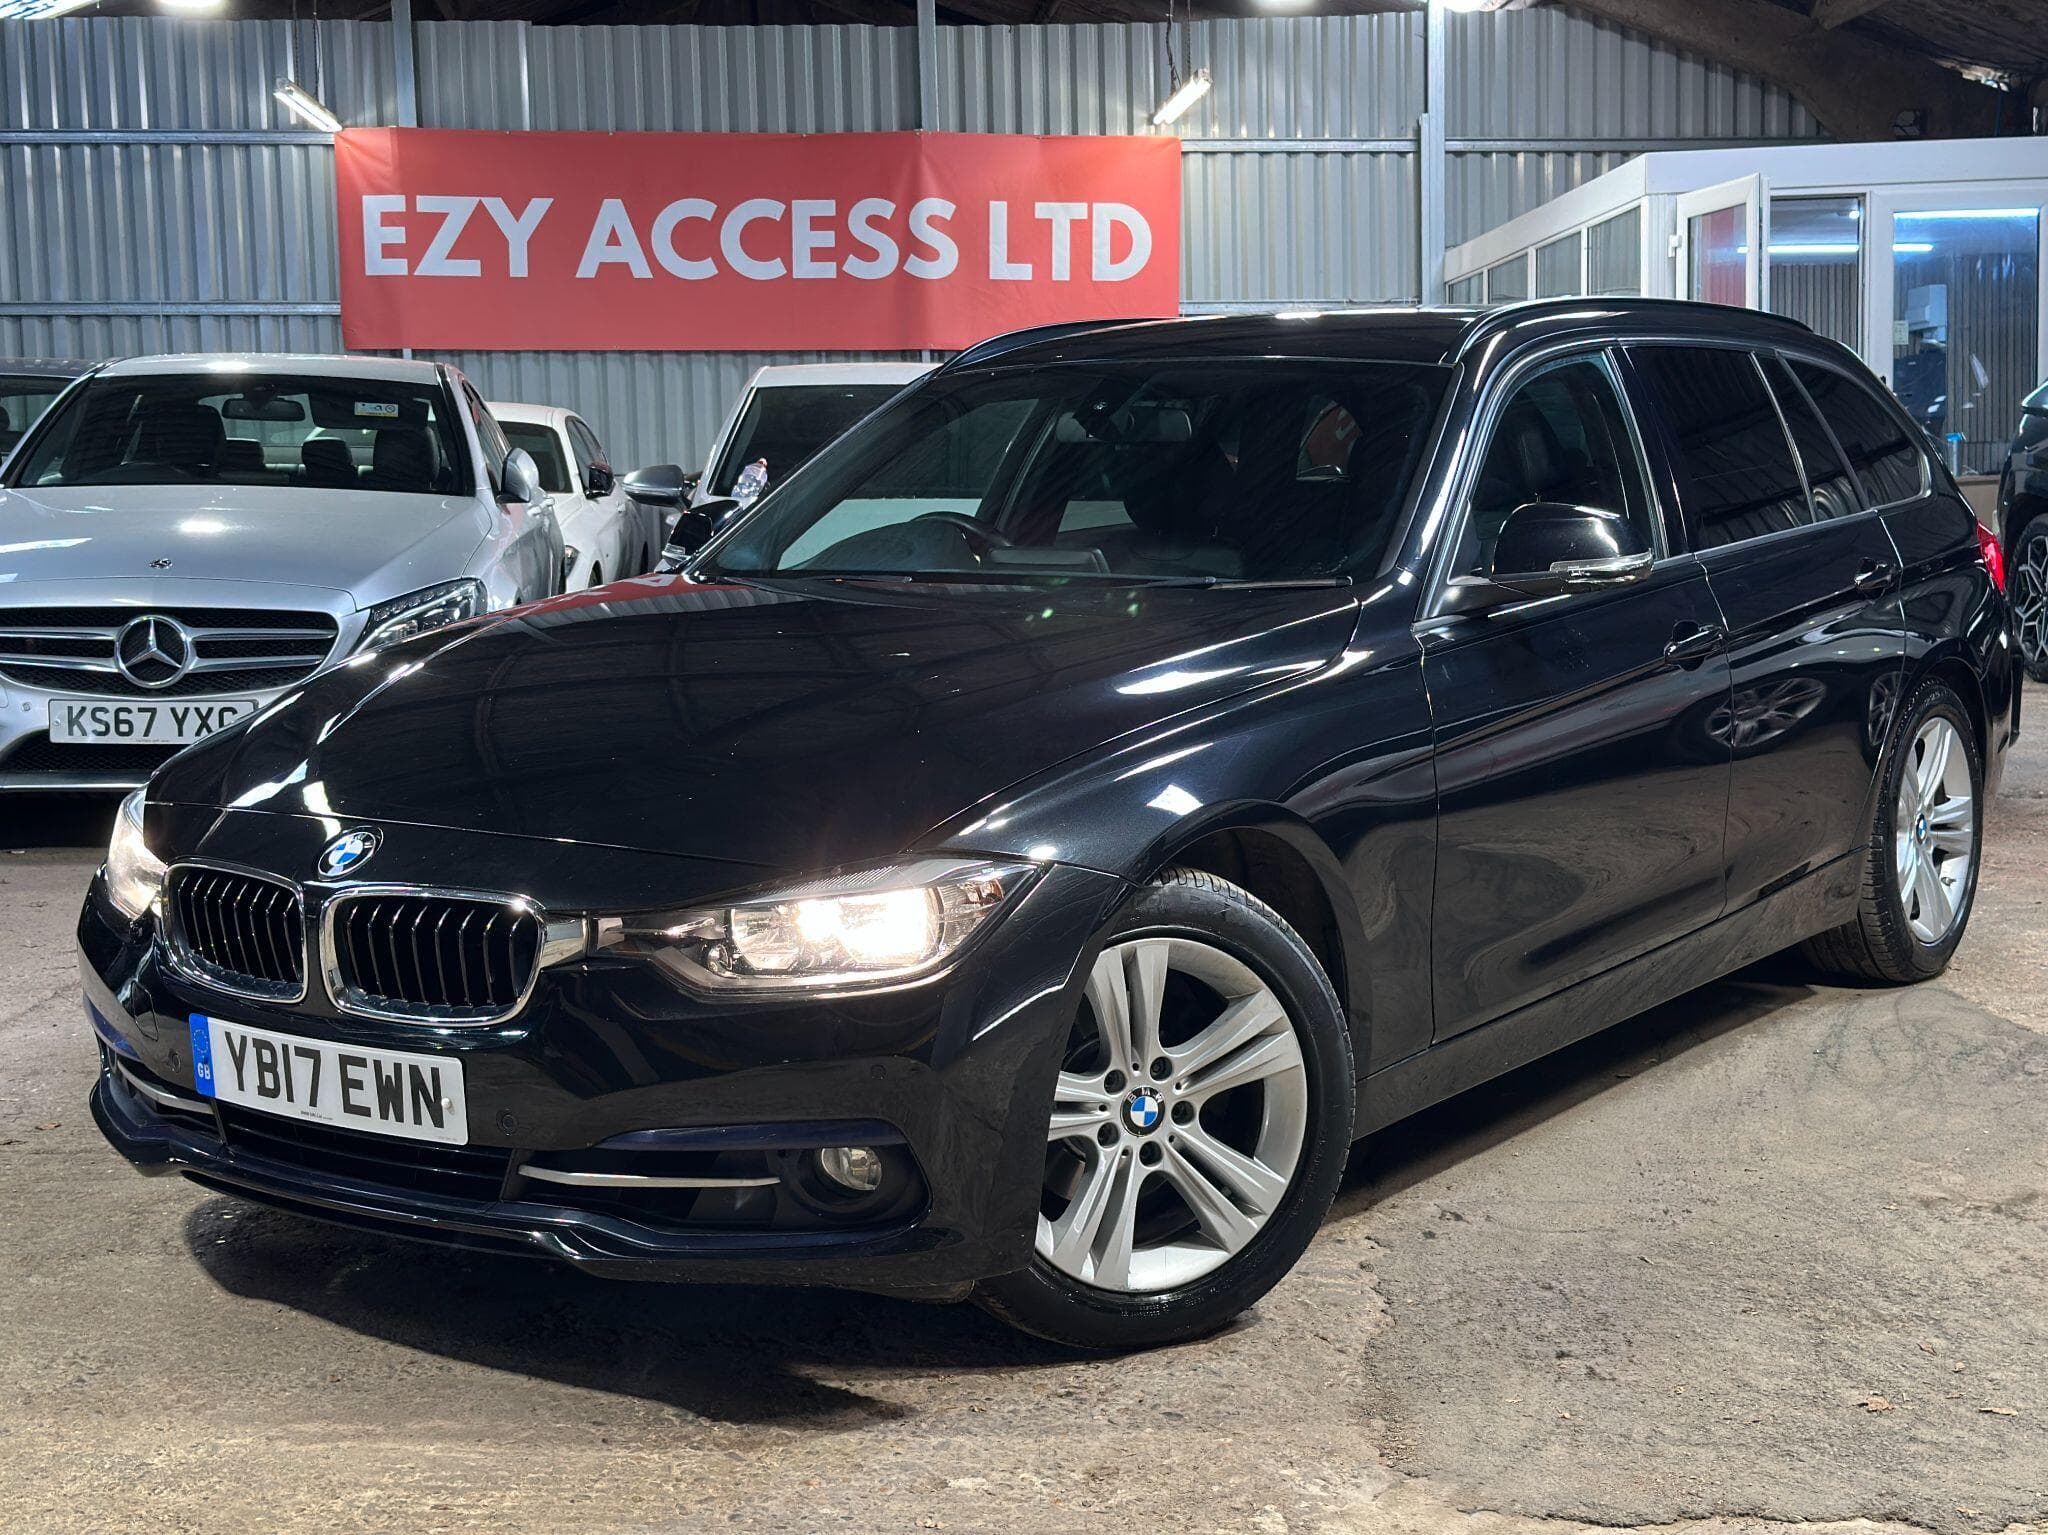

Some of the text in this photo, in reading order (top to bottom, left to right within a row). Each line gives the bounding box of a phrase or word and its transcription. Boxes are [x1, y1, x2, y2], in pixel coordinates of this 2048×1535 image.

[362, 194, 1152, 281] EZY ACCESS LTD
[66, 705, 158, 737] KS67
[197, 1062, 211, 1080] GB
[224, 1031, 445, 1129] YB17 EWN
[1127, 1086, 1164, 1103] BMW
